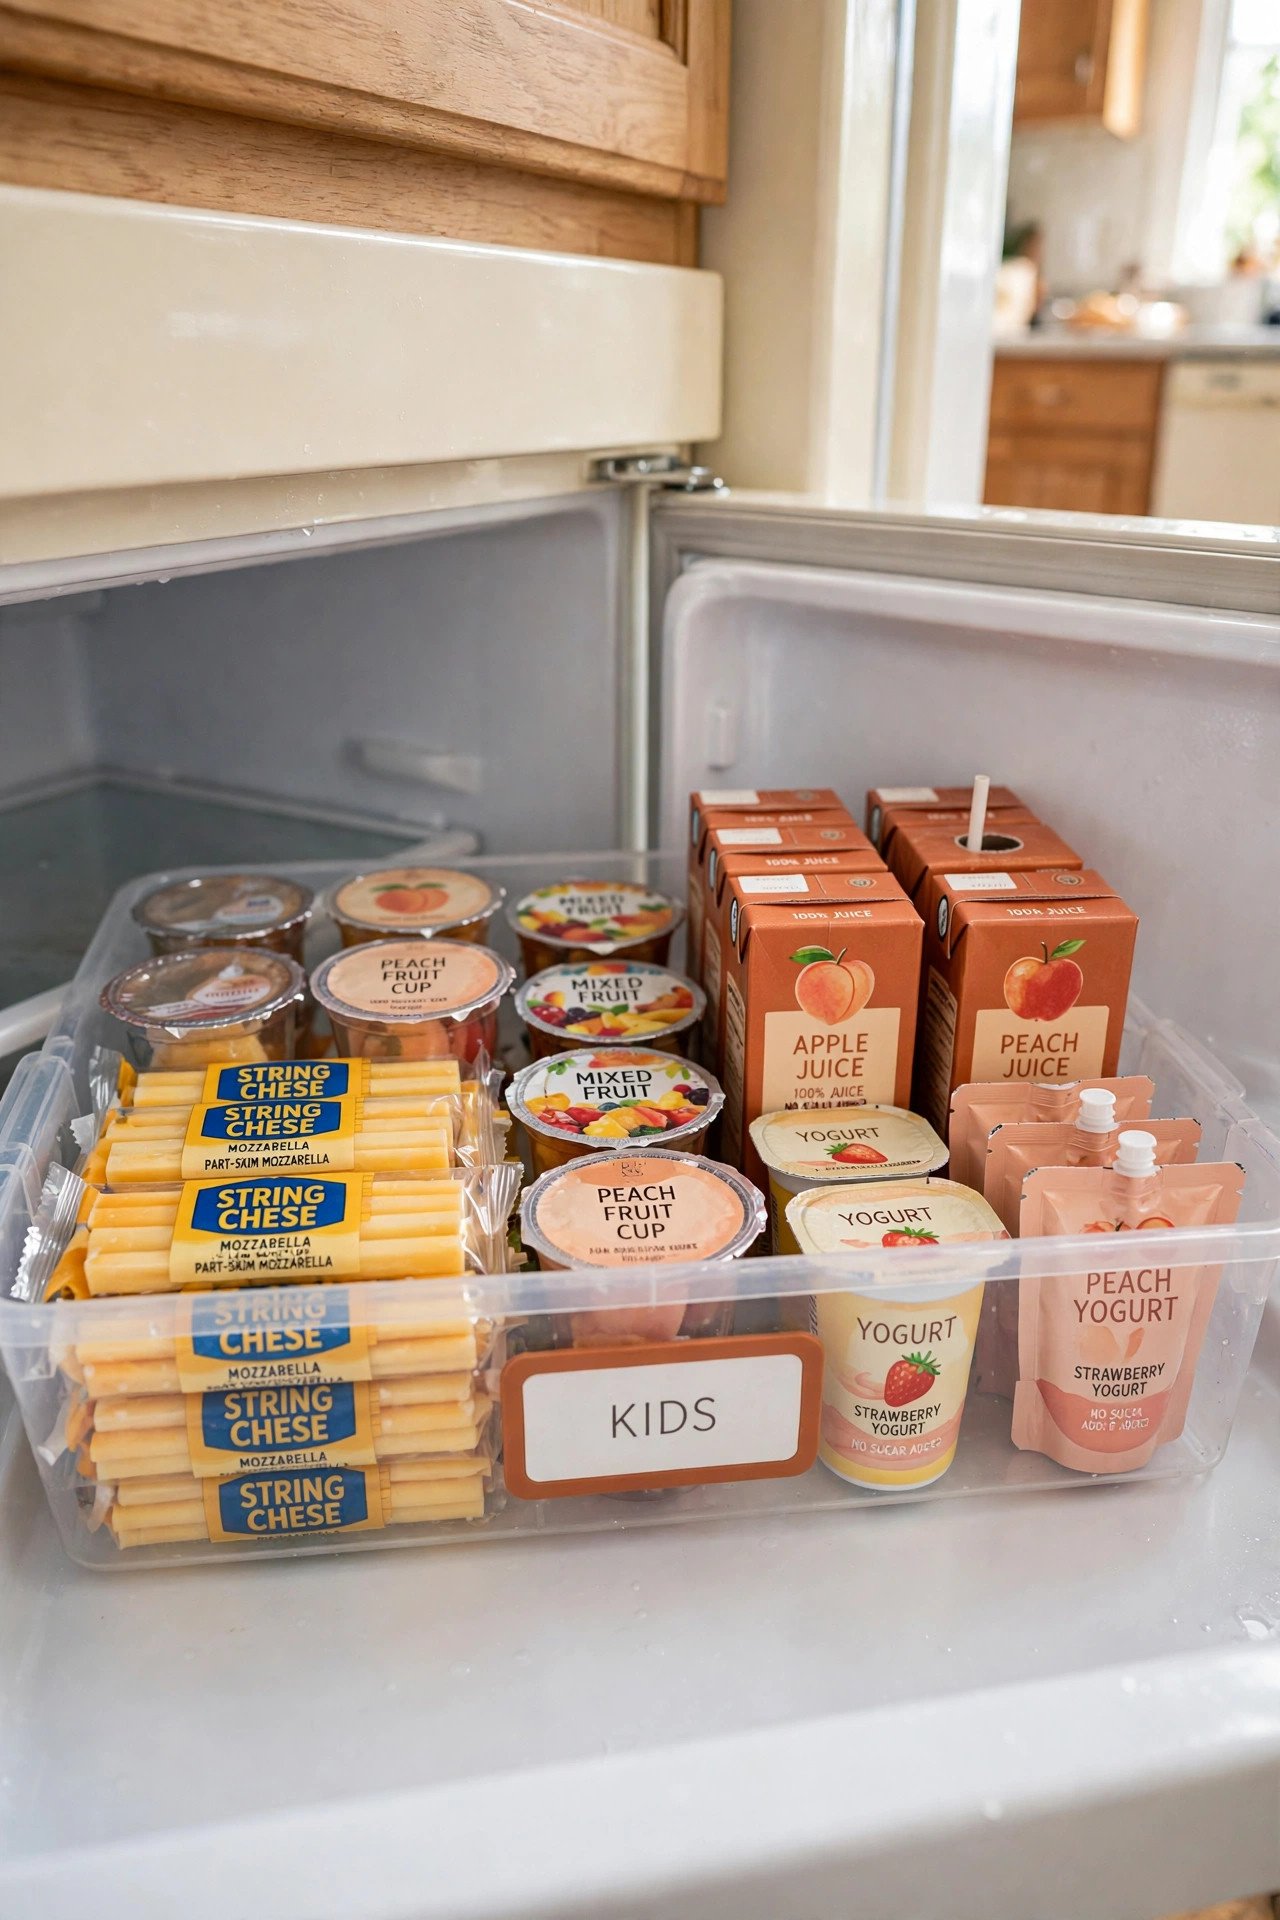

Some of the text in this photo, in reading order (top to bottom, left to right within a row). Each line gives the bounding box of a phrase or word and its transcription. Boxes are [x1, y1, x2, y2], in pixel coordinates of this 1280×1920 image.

[802, 857, 839, 866] JUICE
[833, 910, 873, 919] JUICE
[1048, 906, 1087, 916] JUICE
[381, 957, 446, 970] PEACH
[382, 969, 442, 981] FRUIT
[571, 977, 643, 990] MIXED
[391, 982, 432, 994] CUP
[578, 989, 640, 1003] FRUIT
[792, 1033, 869, 1055] APPLE
[1000, 1032, 1079, 1054] PEACH
[237, 1064, 331, 1083] STRING
[796, 1057, 865, 1080] JUICE
[1002, 1057, 1070, 1078] JUICE
[576, 1070, 652, 1085] MIXED
[240, 1080, 325, 1100] CHESE
[583, 1084, 651, 1100] FRUIT
[794, 1087, 825, 1099] 100%
[224, 1103, 321, 1121] STRING
[226, 1118, 315, 1137] CHESE
[795, 1126, 880, 1143] YOGURT
[262, 1154, 330, 1168] MOZZARELLA
[216, 1184, 325, 1209] STRING
[597, 1185, 676, 1203] PEACH
[218, 1205, 317, 1230] CHESE
[604, 1203, 673, 1221] FRUIT
[838, 1206, 933, 1227] YOGURT
[617, 1223, 665, 1239] CUP
[259, 1256, 333, 1270] MOZZARELLA
[1086, 1268, 1171, 1294] PEACH
[215, 1291, 327, 1325] STRING
[1073, 1296, 1179, 1323] YOGURT
[219, 1320, 323, 1355] CHESE
[857, 1315, 957, 1345] YOGURT
[1074, 1362, 1166, 1381] STRAWBERRY
[1092, 1381, 1148, 1397] YOGURT
[224, 1385, 333, 1420] STRING
[611, 1396, 717, 1439] KIDS
[854, 1403, 942, 1422] STRAWBERRY
[230, 1414, 329, 1447] CHESE
[871, 1421, 926, 1436] YOGURT
[239, 1475, 345, 1508] STRING
[246, 1502, 342, 1532] CHESE
